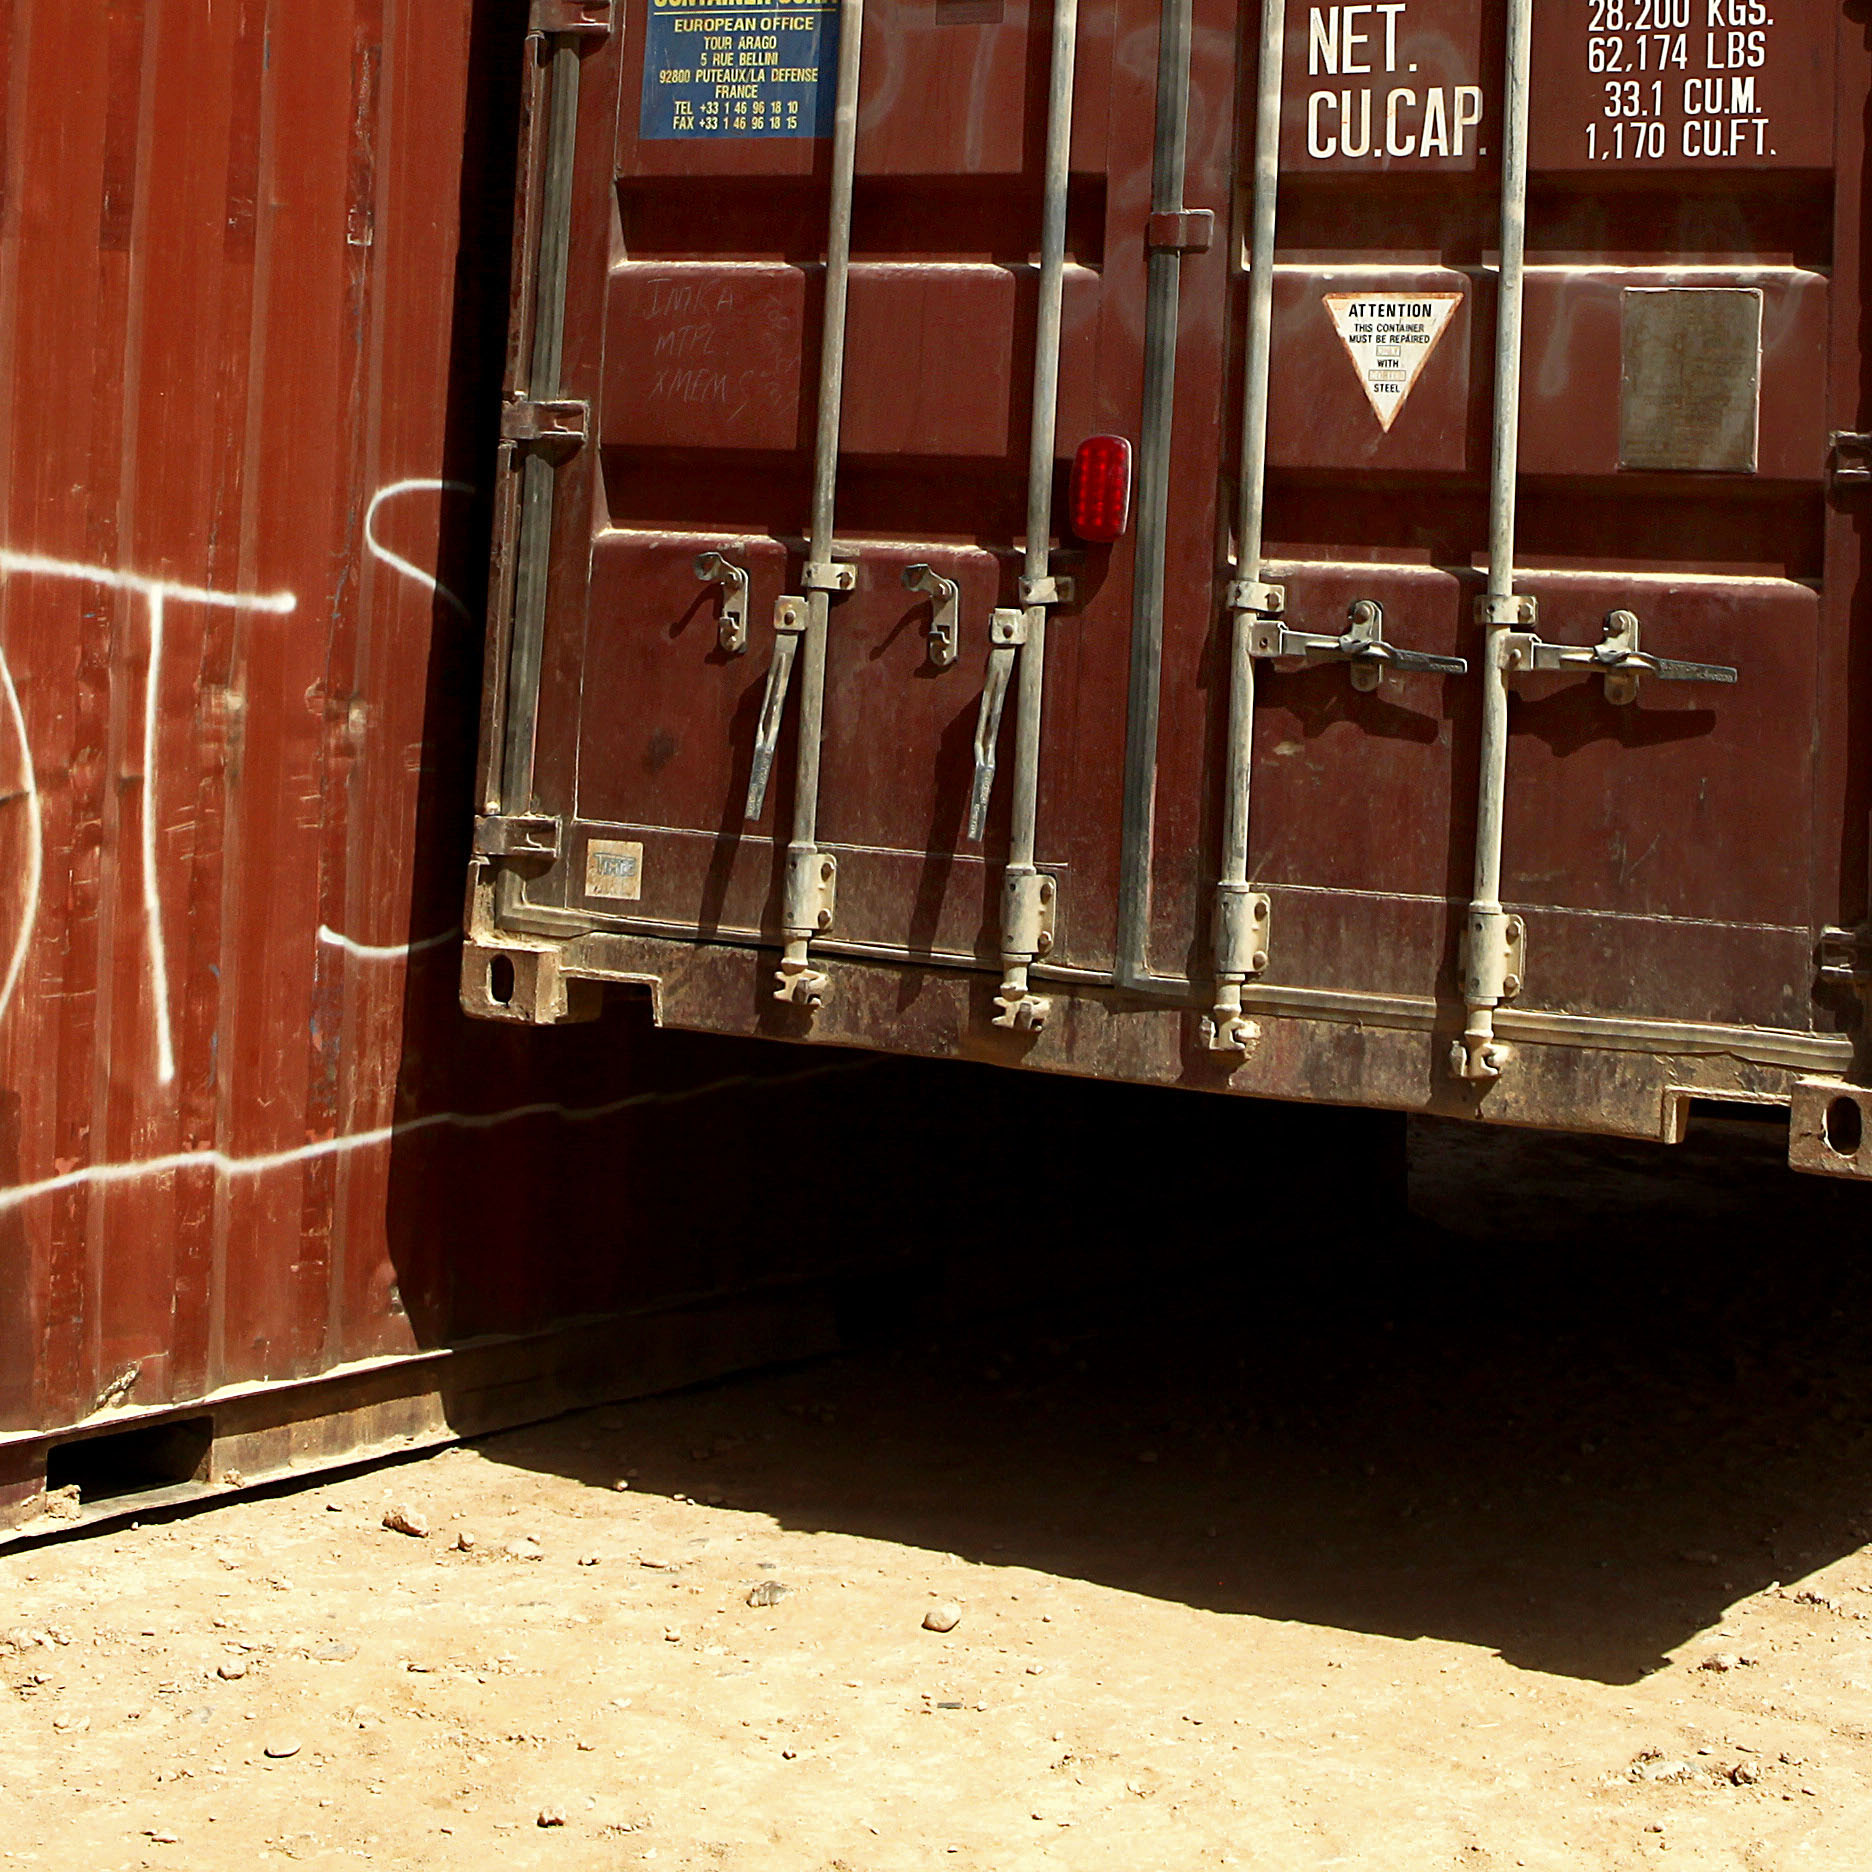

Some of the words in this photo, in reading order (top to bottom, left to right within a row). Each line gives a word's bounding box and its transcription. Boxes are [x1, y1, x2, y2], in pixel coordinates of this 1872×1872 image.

[674, 17, 756, 33] EUROPEAN
[760, 16, 814, 31] OFFICE
[704, 36, 732, 50] TOUR
[738, 35, 777, 49] ARAGO
[1307, 3, 1419, 76] NET.
[701, 53, 708, 66] 5
[713, 52, 734, 66] RUE
[739, 52, 779, 65] BELLINI
[1588, 34, 1688, 74] 62,174
[1706, 31, 1766, 69] LBS
[659, 69, 690, 83] 92800
[695, 69, 765, 83] PUTEAUX/LA
[771, 68, 818, 82] DEFENSE
[715, 85, 758, 99] FRANCE
[1604, 81, 1663, 117] 33.1
[1682, 77, 1762, 115] CU.M.
[674, 101, 693, 115] TEL
[699, 100, 719, 115] +33
[724, 101, 730, 114] 1
[734, 101, 747, 115] 46
[752, 101, 765, 115] 96
[770, 101, 782, 115] 18
[787, 101, 798, 114] 10
[673, 116, 694, 130] FAX
[699, 116, 718, 130] +33
[723, 116, 729, 129] 1
[733, 116, 746, 130] 46
[751, 116, 764, 130] 96
[769, 116, 781, 129] 18
[786, 116, 797, 129] 15
[1307, 85, 1488, 159] CU.CAP.
[1586, 123, 1664, 161] 1,170
[1682, 119, 1776, 156] CU.FT.
[1349, 303, 1432, 318] ATTENTION
[1355, 323, 1373, 333] THIS
[1376, 323, 1424, 333] CONTAINER
[1349, 334, 1372, 344] MUST
[1375, 334, 1387, 344] BE
[1389, 334, 1430, 344] REPAIRED
[1377, 359, 1399, 368] WITH
[1373, 383, 1400, 393] STEEL
